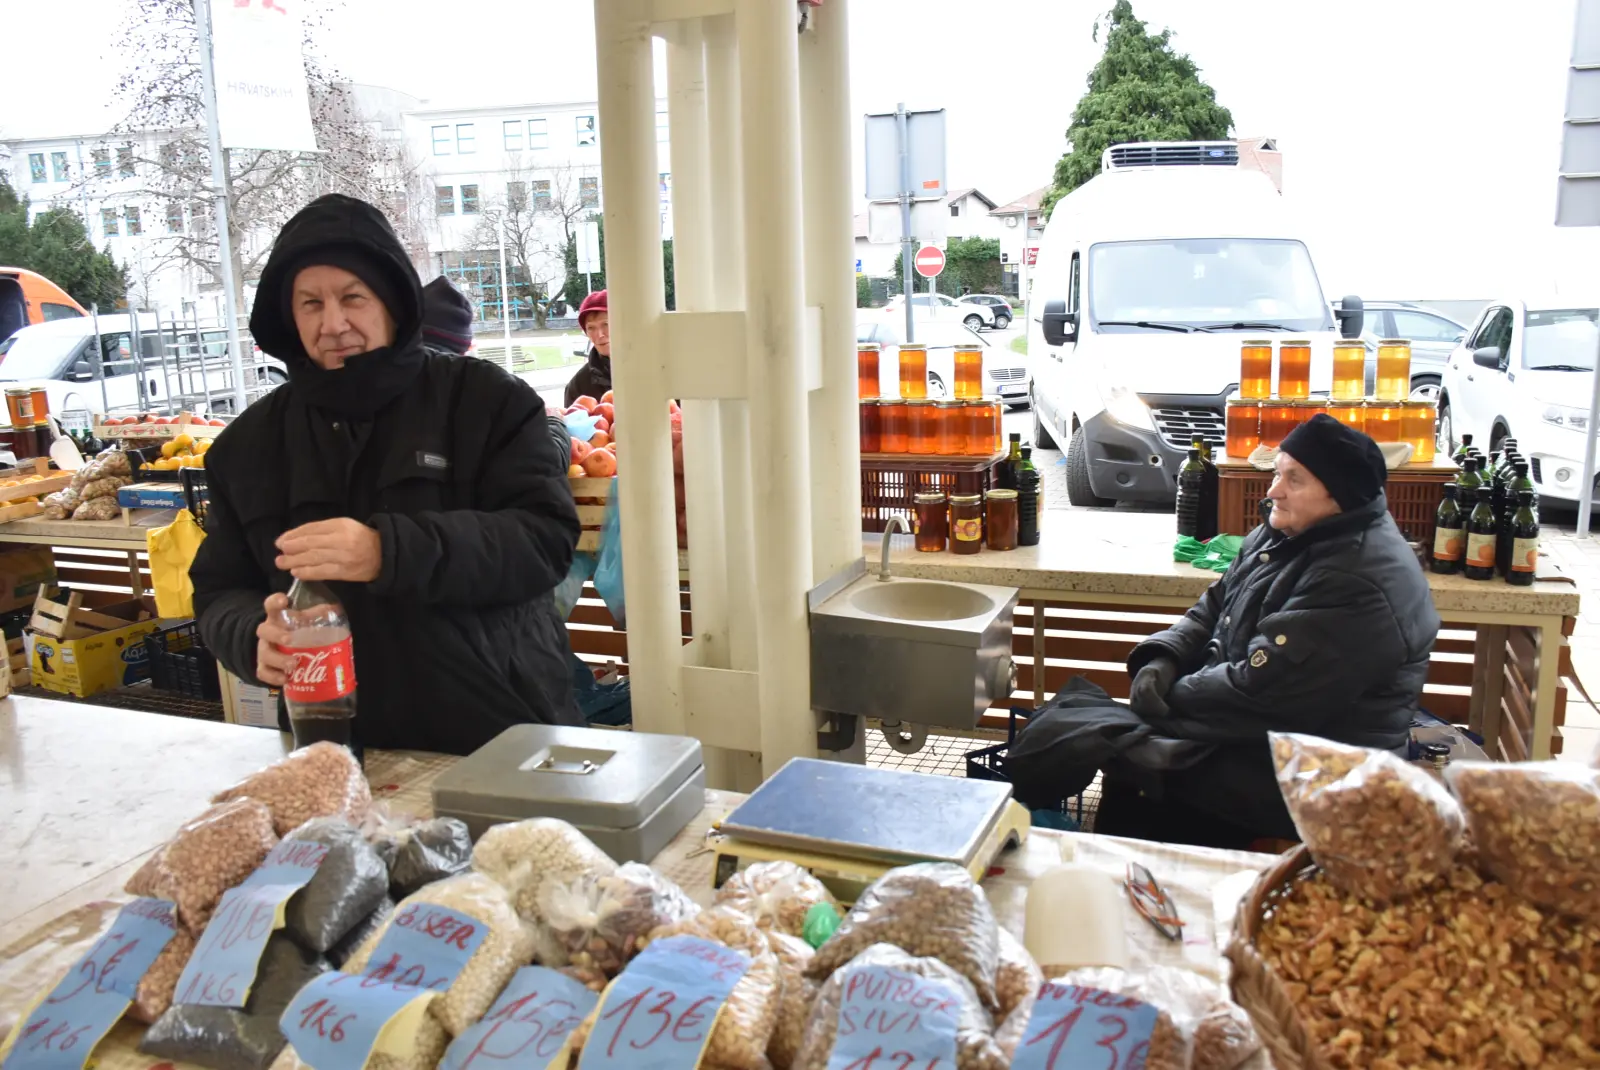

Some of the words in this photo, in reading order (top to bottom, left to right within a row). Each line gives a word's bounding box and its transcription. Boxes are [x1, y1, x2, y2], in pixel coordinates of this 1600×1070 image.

[227, 80, 294, 98] HRVATSKIH
[603, 986, 717, 1057] 13€
[840, 1005, 920, 1036] SIVI
